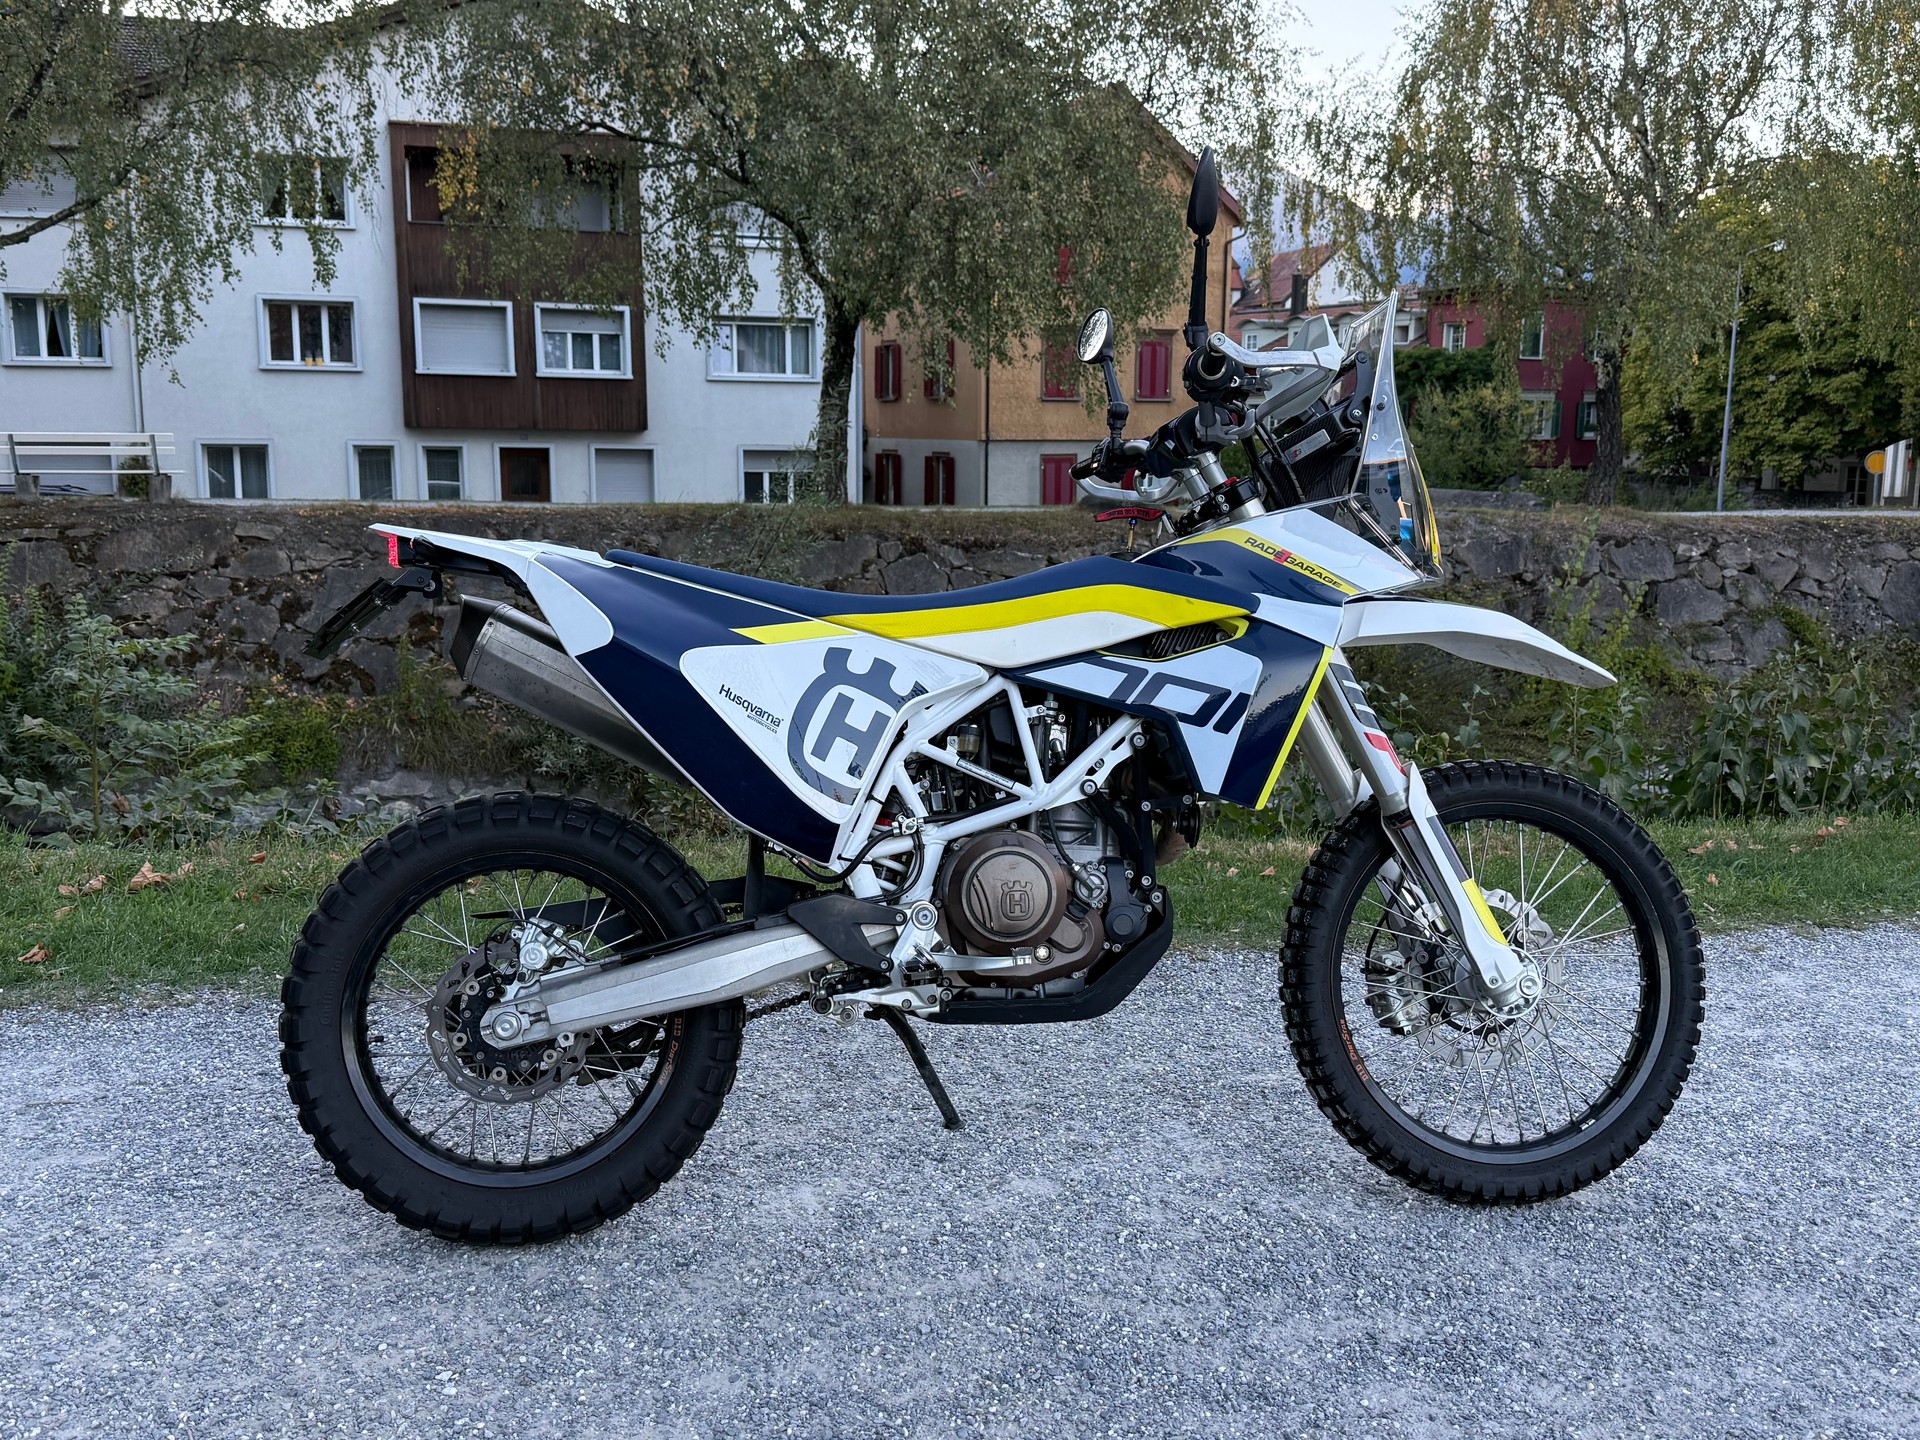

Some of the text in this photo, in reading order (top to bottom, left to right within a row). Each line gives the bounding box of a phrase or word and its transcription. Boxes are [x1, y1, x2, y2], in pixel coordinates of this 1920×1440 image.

[1244, 537, 1342, 588] RADE GARAGE
[719, 684, 780, 727] Husqvarna
[747, 714, 778, 734] MOTORCYCLES
